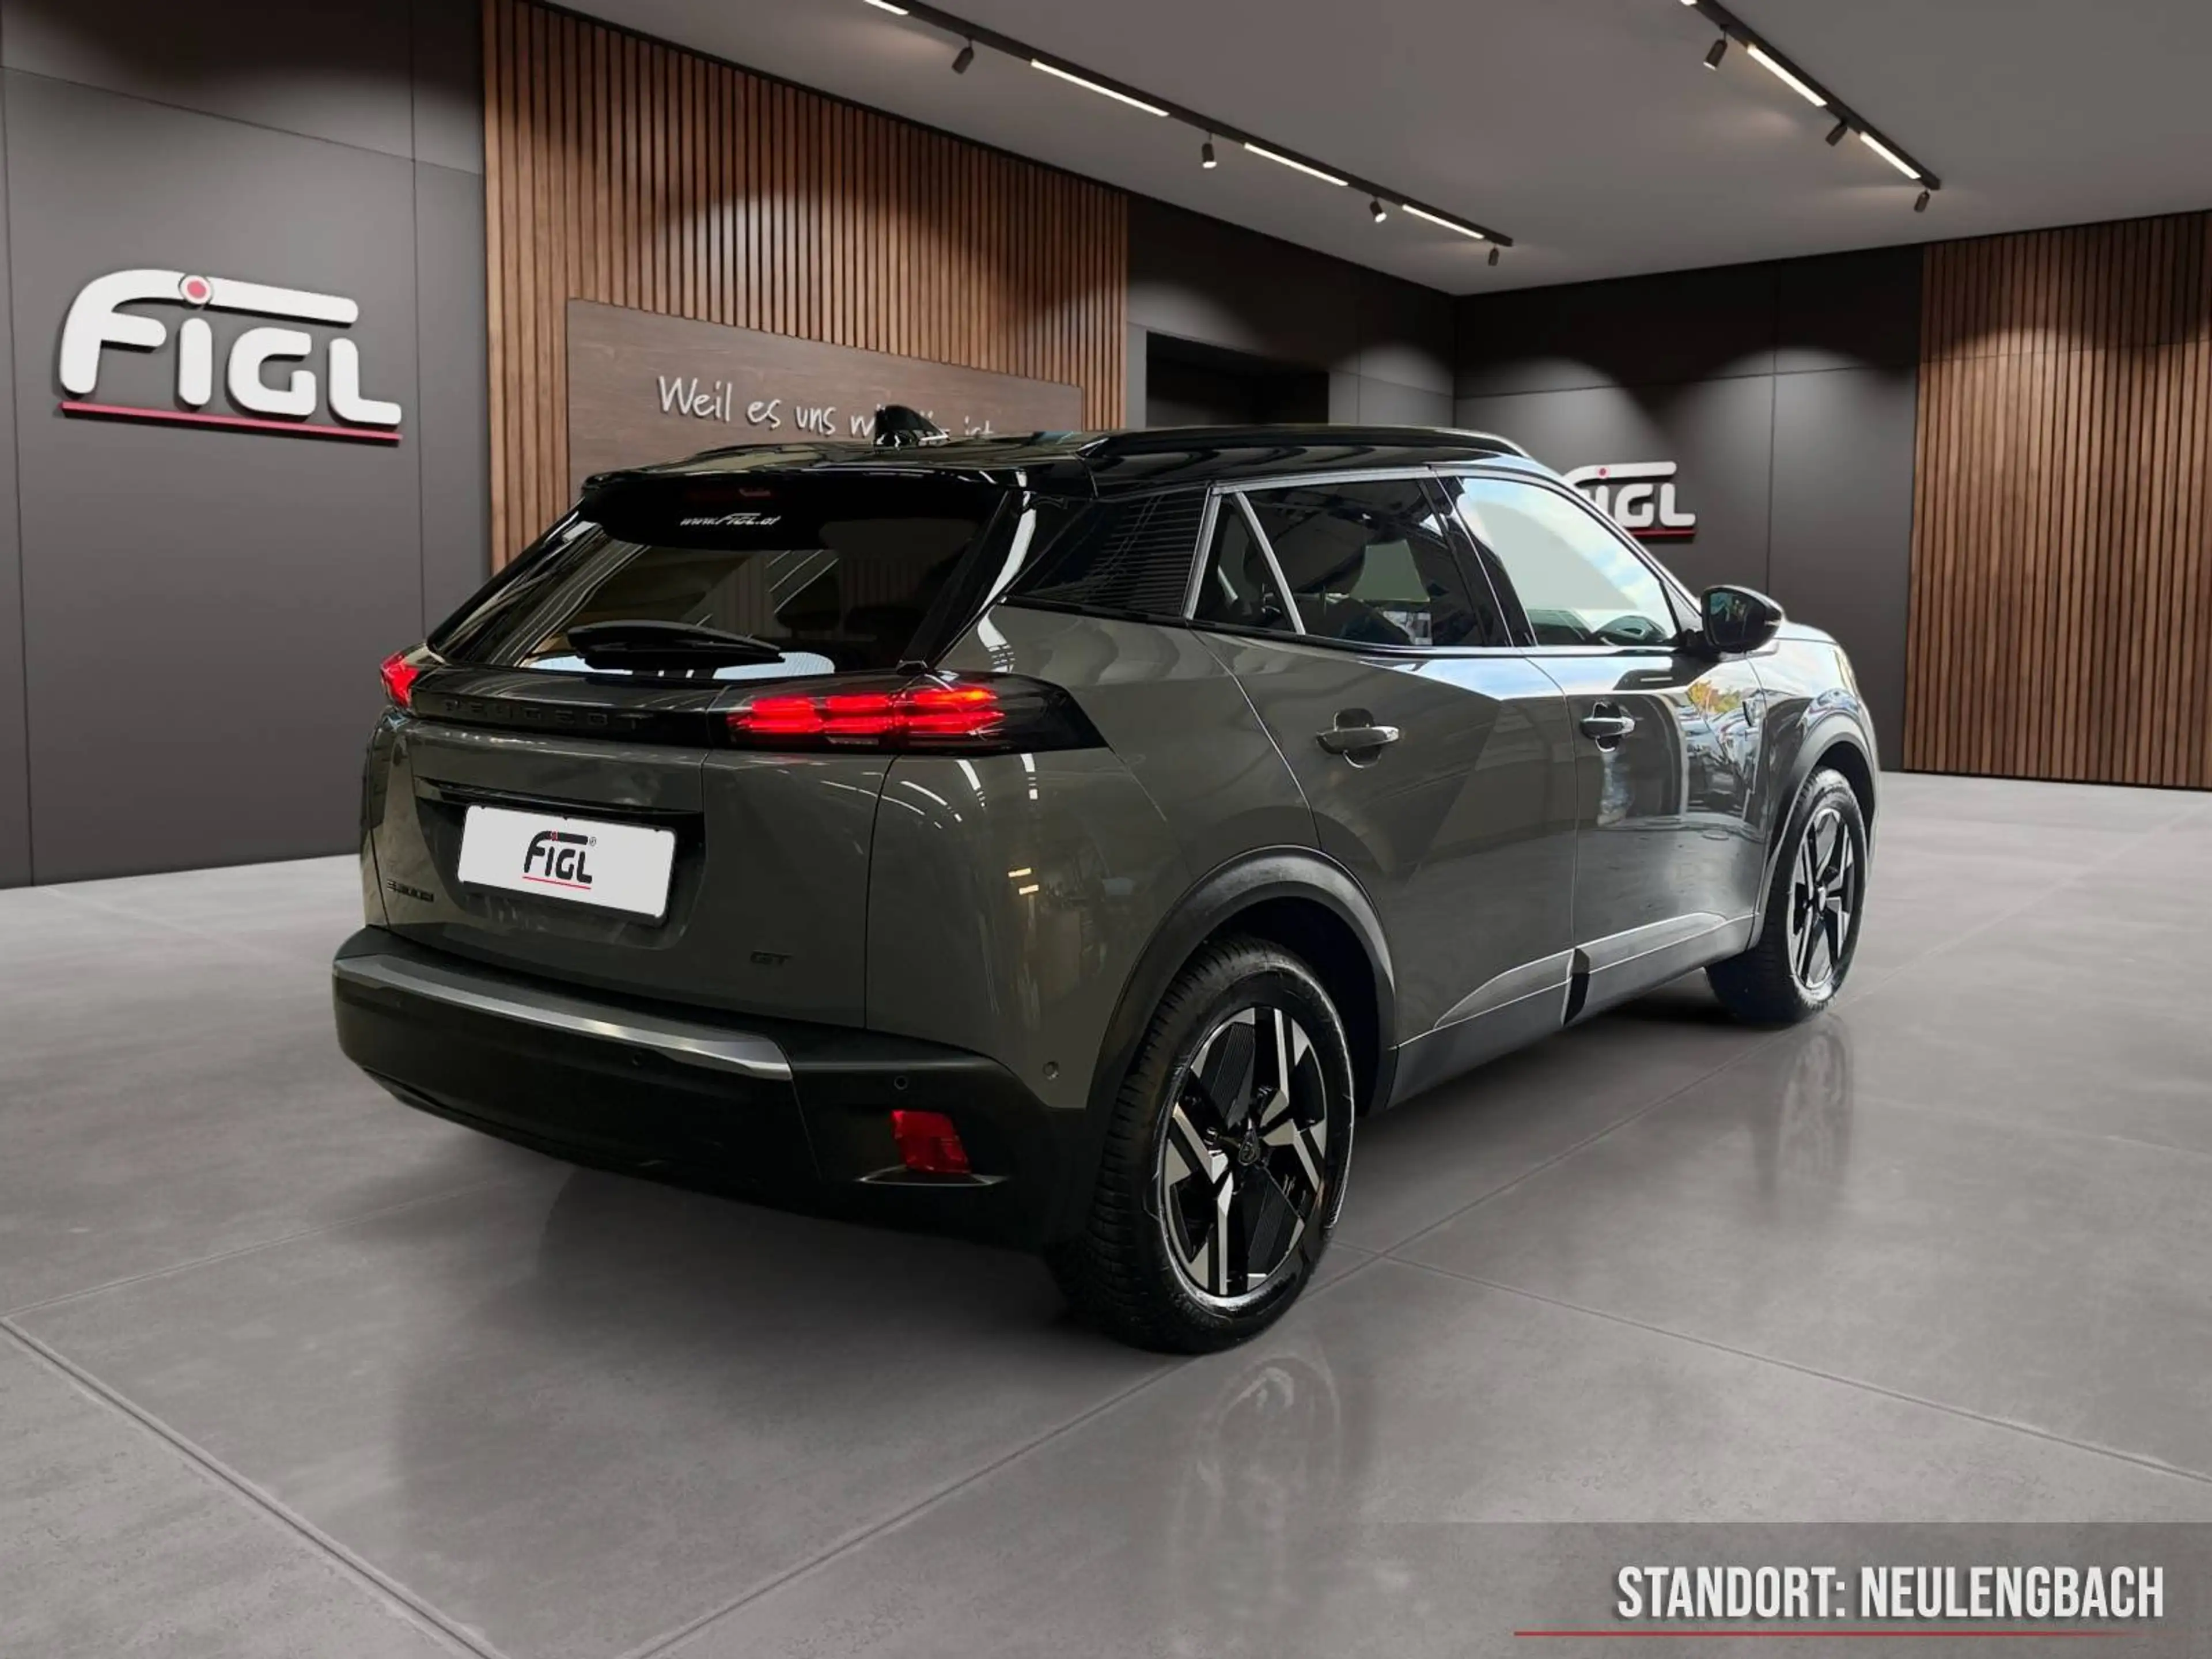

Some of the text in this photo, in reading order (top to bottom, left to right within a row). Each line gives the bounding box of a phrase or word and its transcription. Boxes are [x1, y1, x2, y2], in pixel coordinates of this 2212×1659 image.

[658, 376, 732, 423] Weil
[747, 399, 781, 430] es
[796, 406, 836, 437] uns
